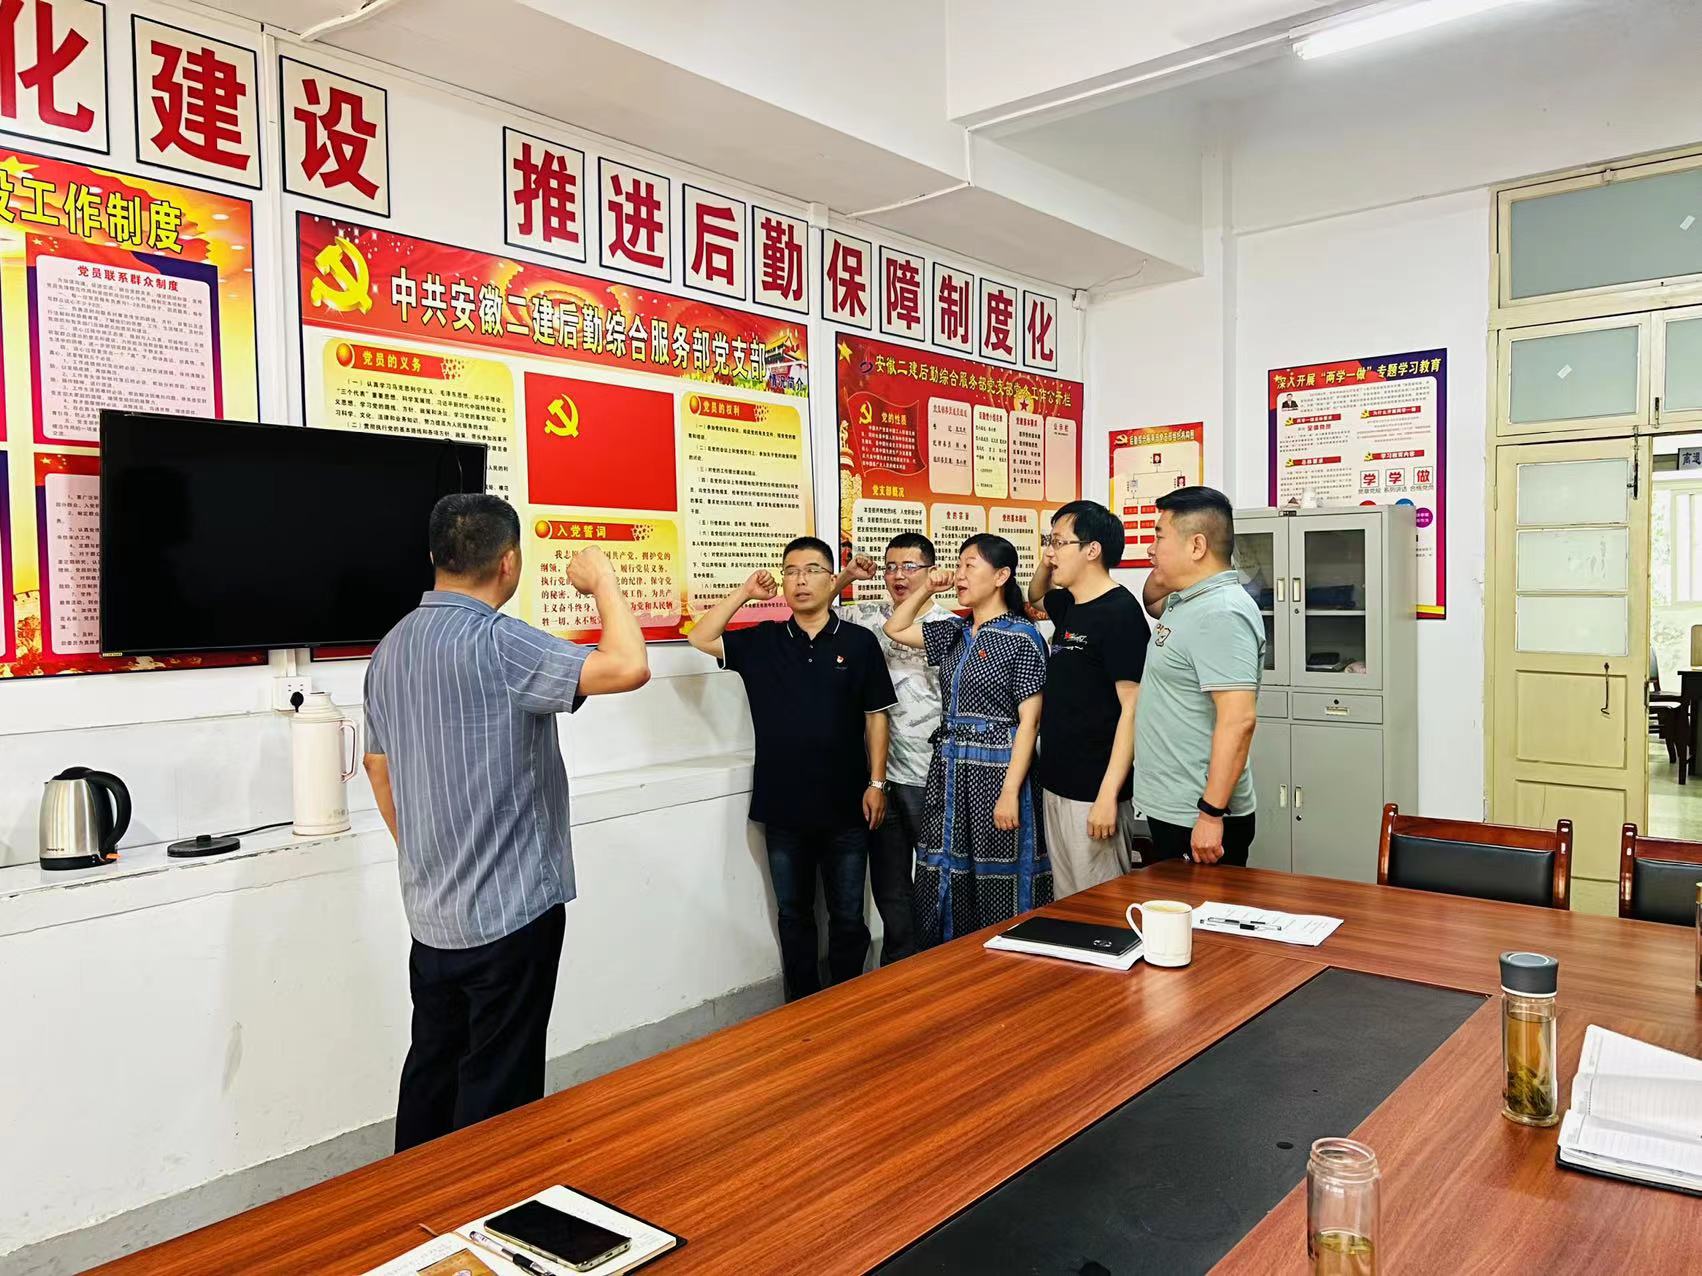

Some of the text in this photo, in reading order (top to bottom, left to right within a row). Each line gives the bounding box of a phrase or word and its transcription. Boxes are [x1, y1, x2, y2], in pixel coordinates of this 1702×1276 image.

[513, 142, 1054, 362] 推进后勤保障制度化
[77, 265, 180, 292] 党员联系群众制度
[391, 267, 767, 383] 中共安徽二建后勤综合服务部党支部
[362, 350, 422, 373] 党员的义务
[703, 402, 741, 417] 党员的权利
[1363, 473, 1376, 486] 学
[1388, 471, 1402, 484] 学
[1416, 469, 1430, 483] 做
[556, 525, 607, 538] 入党誓词
